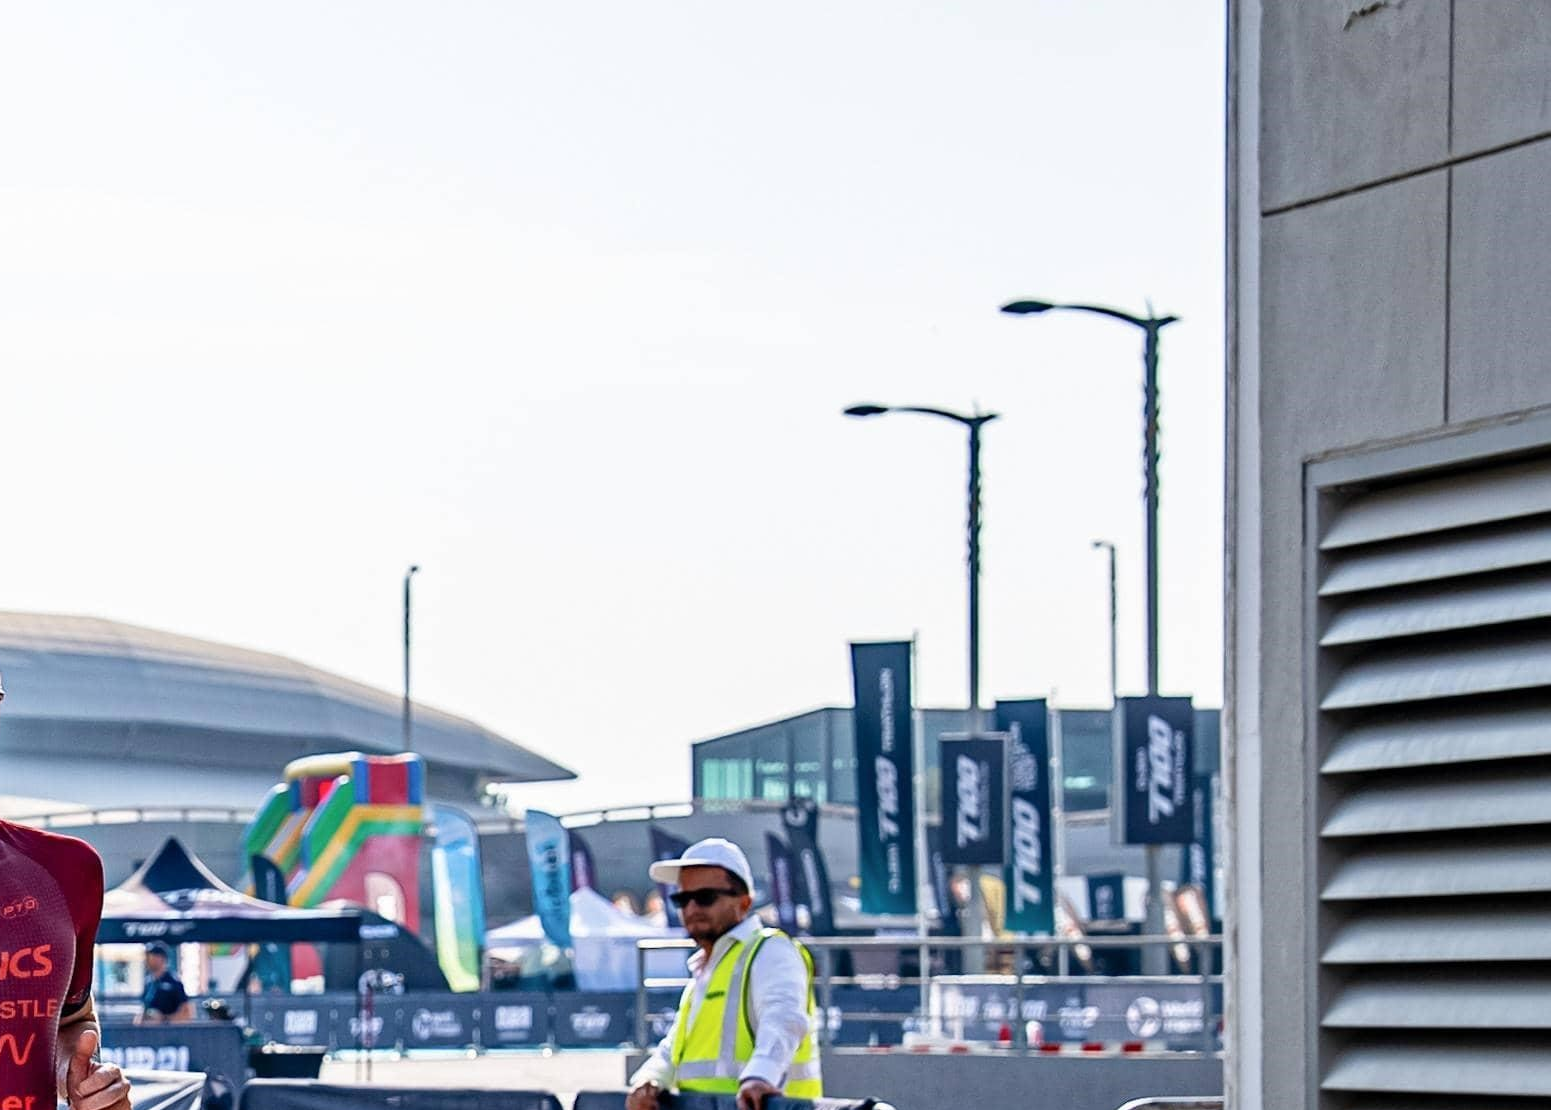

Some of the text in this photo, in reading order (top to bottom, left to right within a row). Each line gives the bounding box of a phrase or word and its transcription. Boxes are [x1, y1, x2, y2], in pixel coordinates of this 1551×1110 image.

[956, 754, 980, 848] T100
[1148, 714, 1174, 825] T100
[1013, 796, 1042, 912] T100
